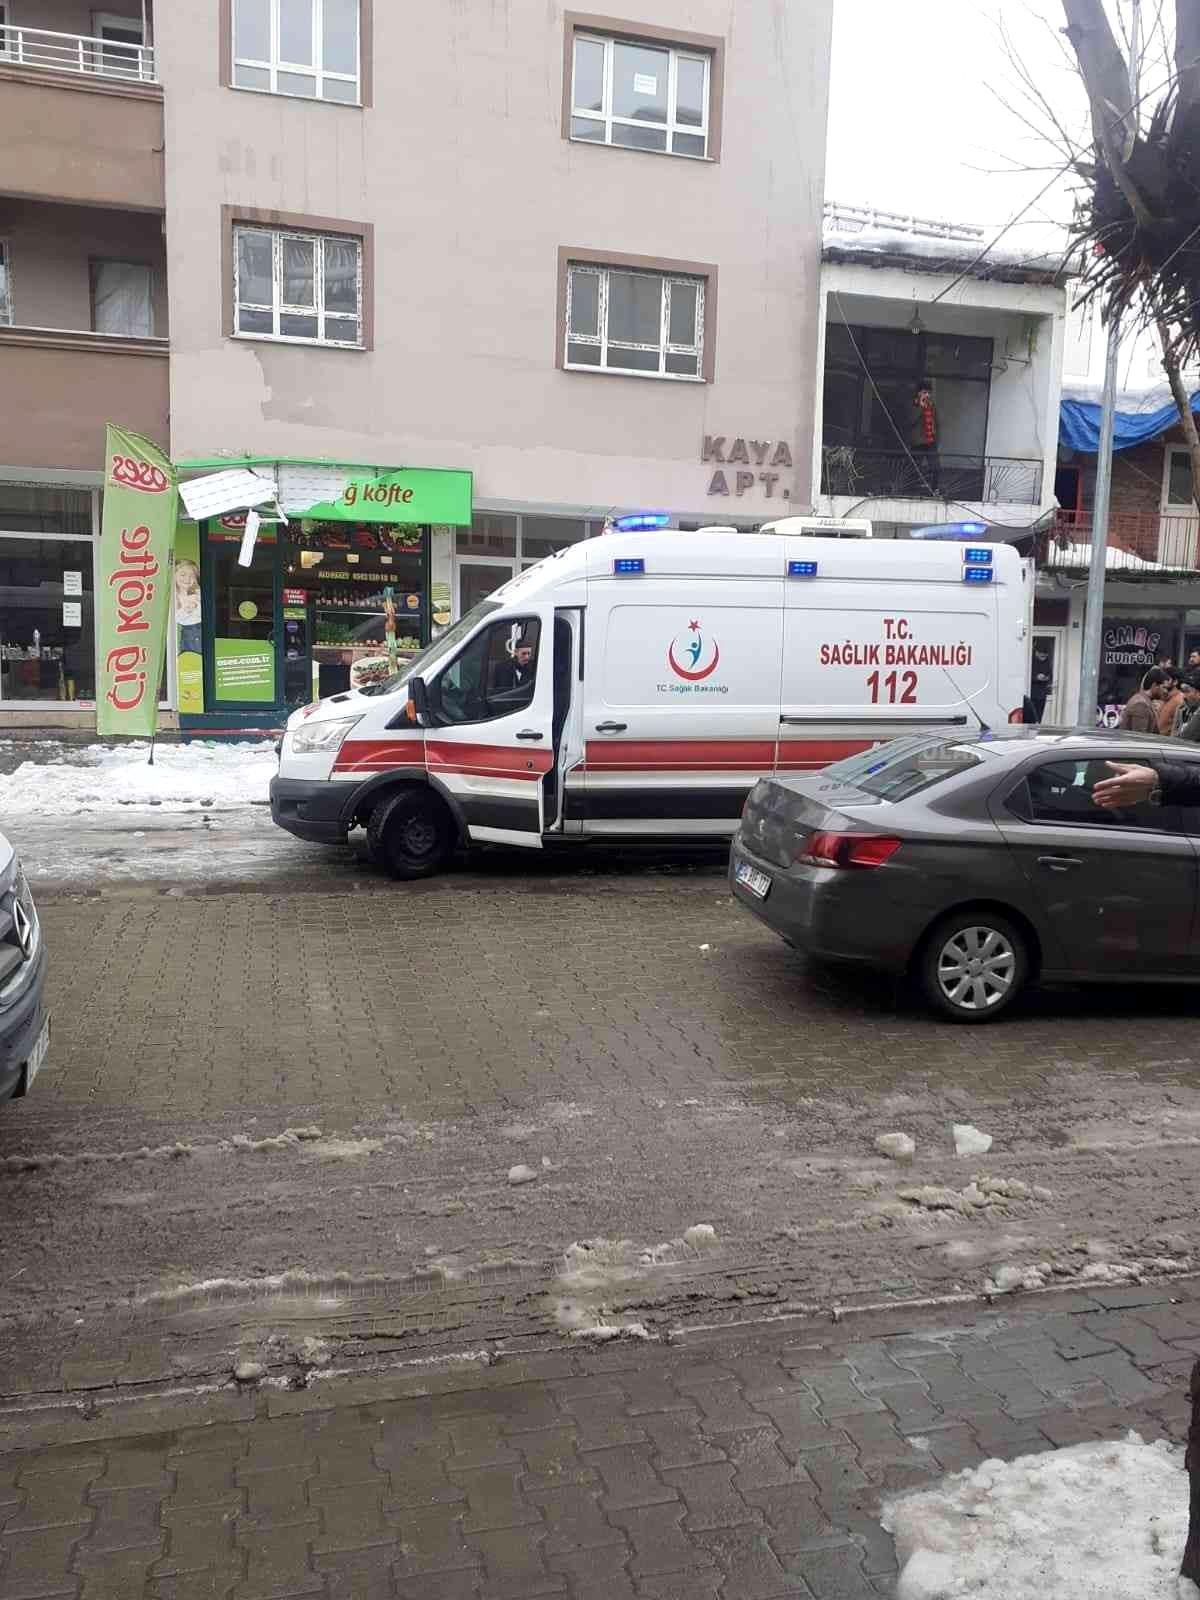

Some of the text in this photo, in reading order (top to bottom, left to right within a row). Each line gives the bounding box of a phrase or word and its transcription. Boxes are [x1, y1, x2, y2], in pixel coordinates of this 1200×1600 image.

[703, 436, 792, 467] KAYA
[363, 483, 414, 507] köfte
[706, 470, 790, 499] APT.
[884, 618, 913, 640] T.C.
[820, 640, 973, 666] SAĞLIK BAKANLIĞI
[866, 670, 919, 704] 112
